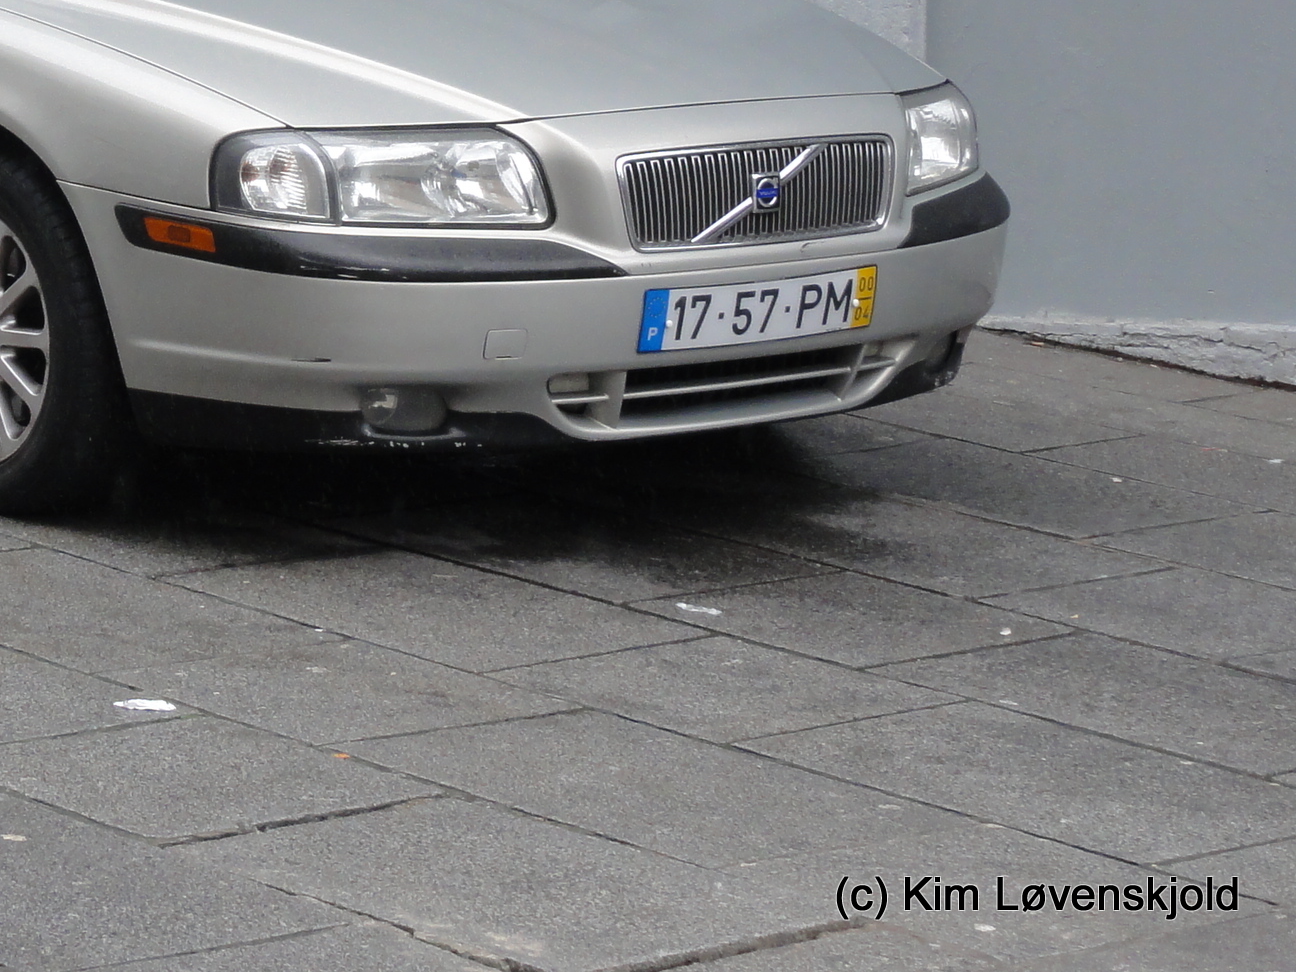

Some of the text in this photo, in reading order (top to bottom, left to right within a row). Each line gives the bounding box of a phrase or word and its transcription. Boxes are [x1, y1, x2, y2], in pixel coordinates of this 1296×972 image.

[859, 276, 874, 293] 00
[854, 305, 870, 321] 04
[646, 326, 659, 341] P
